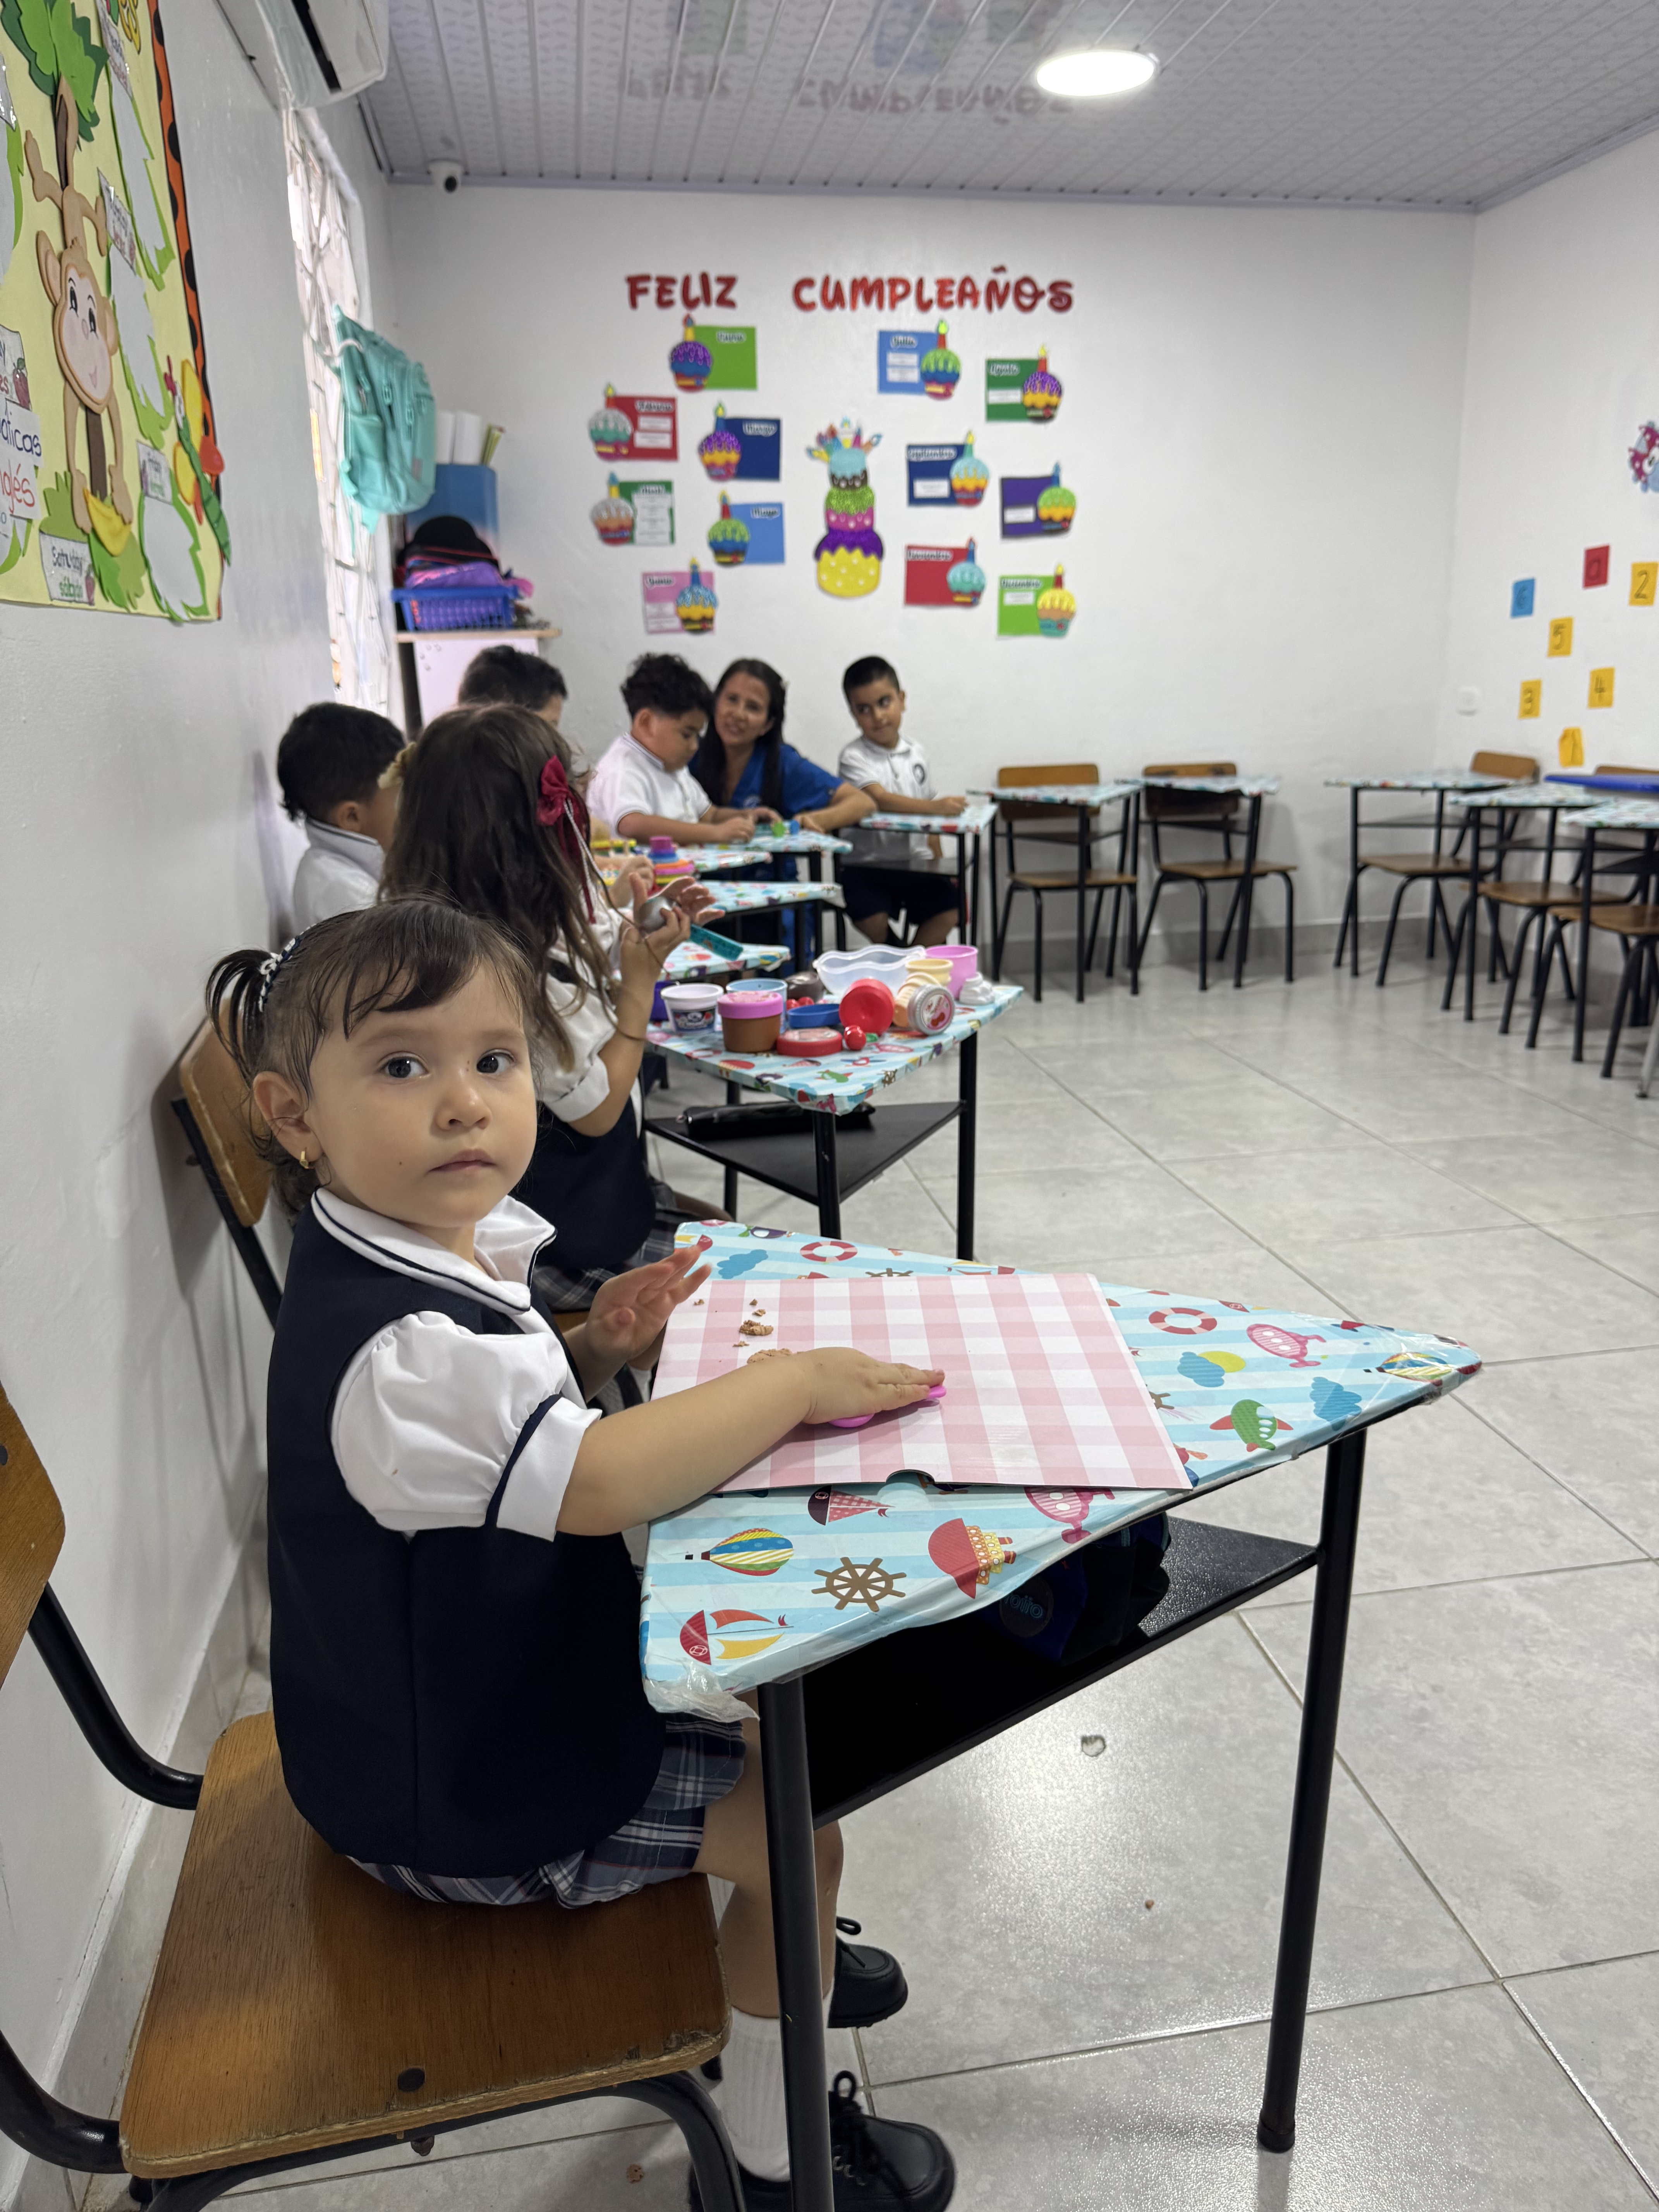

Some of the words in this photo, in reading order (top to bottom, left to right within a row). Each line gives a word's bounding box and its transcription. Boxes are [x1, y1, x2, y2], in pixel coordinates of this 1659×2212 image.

[625, 271, 738, 310] FELIZ
[793, 264, 1074, 312] CUMPLEAÑOS
[1633, 570, 1649, 599] 2
[1553, 623, 1565, 650] 5
[1523, 687, 1533, 715] 3
[1594, 675, 1605, 702] 4
